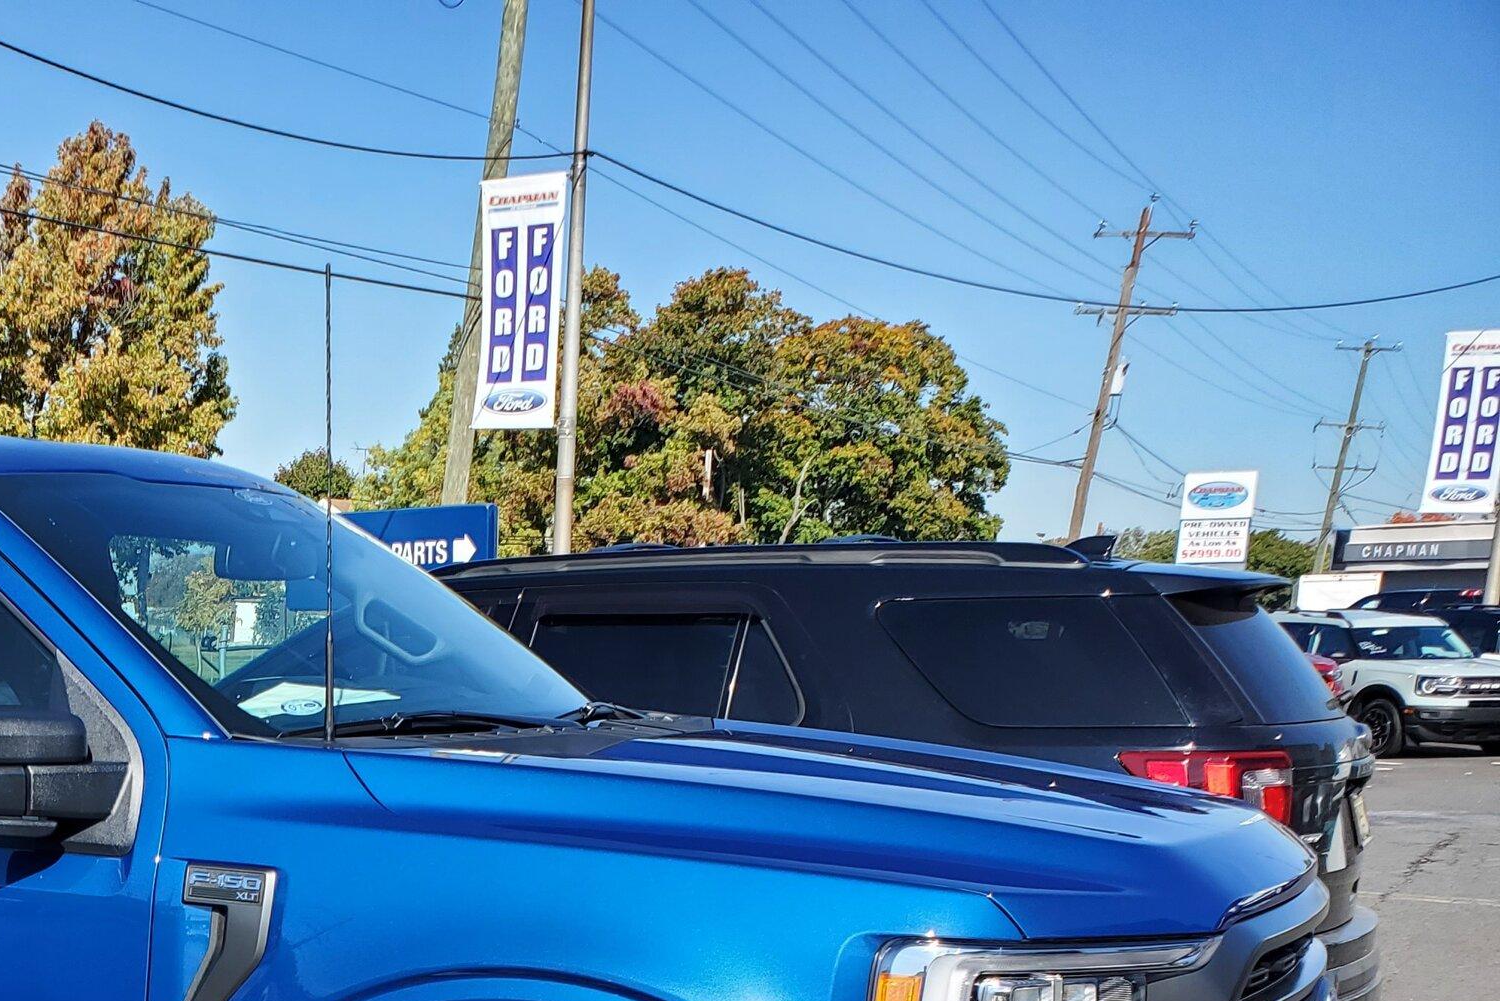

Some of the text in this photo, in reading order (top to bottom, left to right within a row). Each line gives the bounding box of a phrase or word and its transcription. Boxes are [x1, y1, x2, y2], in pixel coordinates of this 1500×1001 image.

[491, 231, 514, 373] FORD
[524, 227, 548, 371] FORD
[492, 391, 535, 411] Ford
[1439, 369, 1471, 473] FORD
[1470, 368, 1500, 473] FORD
[1438, 487, 1478, 502] Ford
[1361, 543, 1440, 558] CHAPMAN
[189, 872, 261, 891] F-150
[235, 891, 258, 901] XLT
